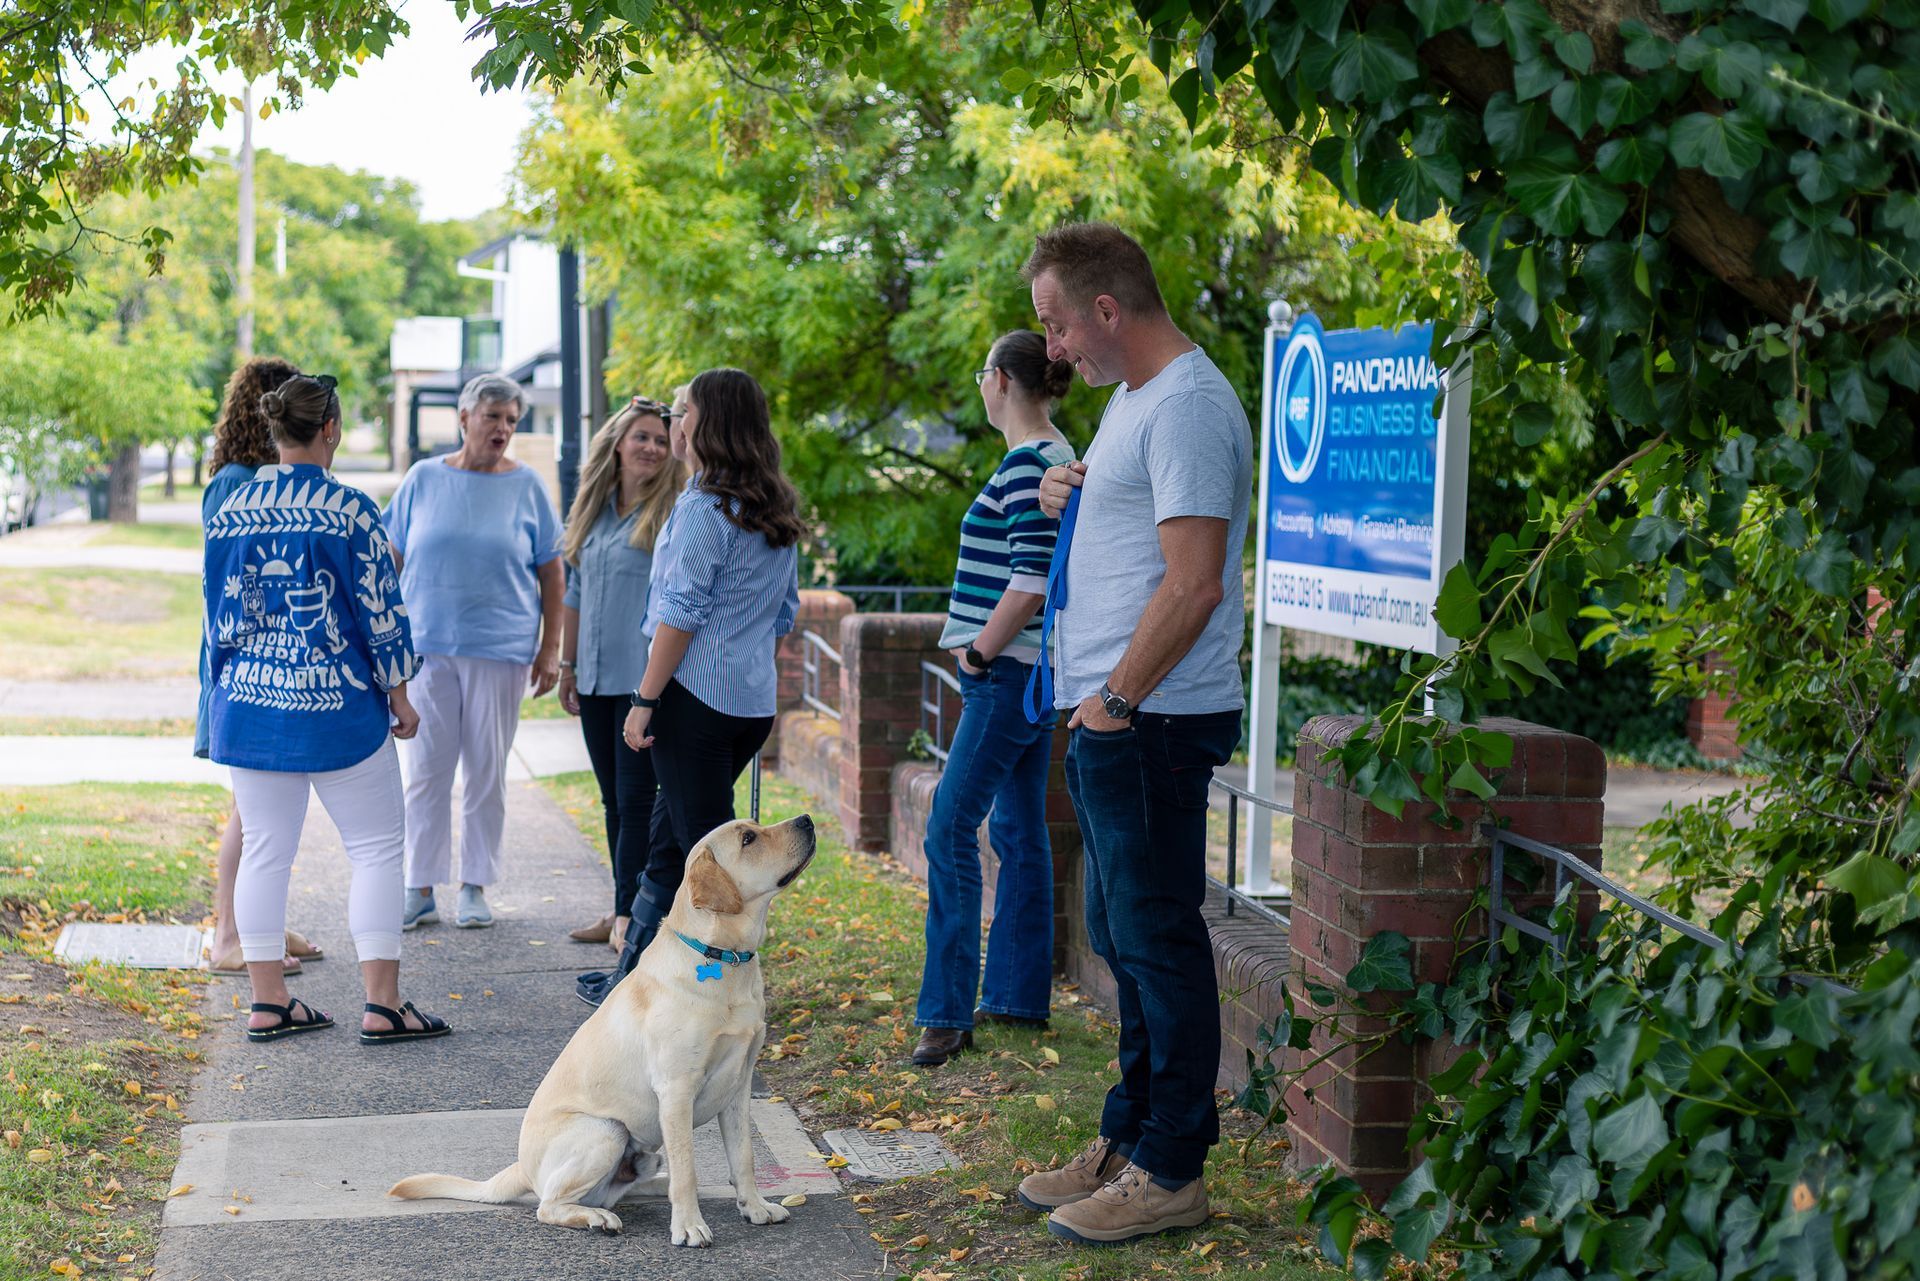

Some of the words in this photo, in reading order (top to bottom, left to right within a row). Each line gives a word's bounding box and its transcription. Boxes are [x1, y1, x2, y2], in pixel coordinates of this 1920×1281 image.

[1331, 355, 1438, 395] PANORAMA
[1330, 402, 1416, 437] BUSINESS
[1421, 401, 1435, 435] &
[1327, 448, 1433, 483] FINANCIAL
[1276, 510, 1314, 539] Accounting
[1322, 512, 1353, 542] Advisory
[1362, 514, 1397, 540] Financial
[1398, 517, 1432, 549] Planning
[1327, 583, 1428, 626] www.pbandf.com.au
[256, 614, 288, 631] THIS
[310, 646, 326, 664] A
[234, 661, 342, 690] MARGARITA
